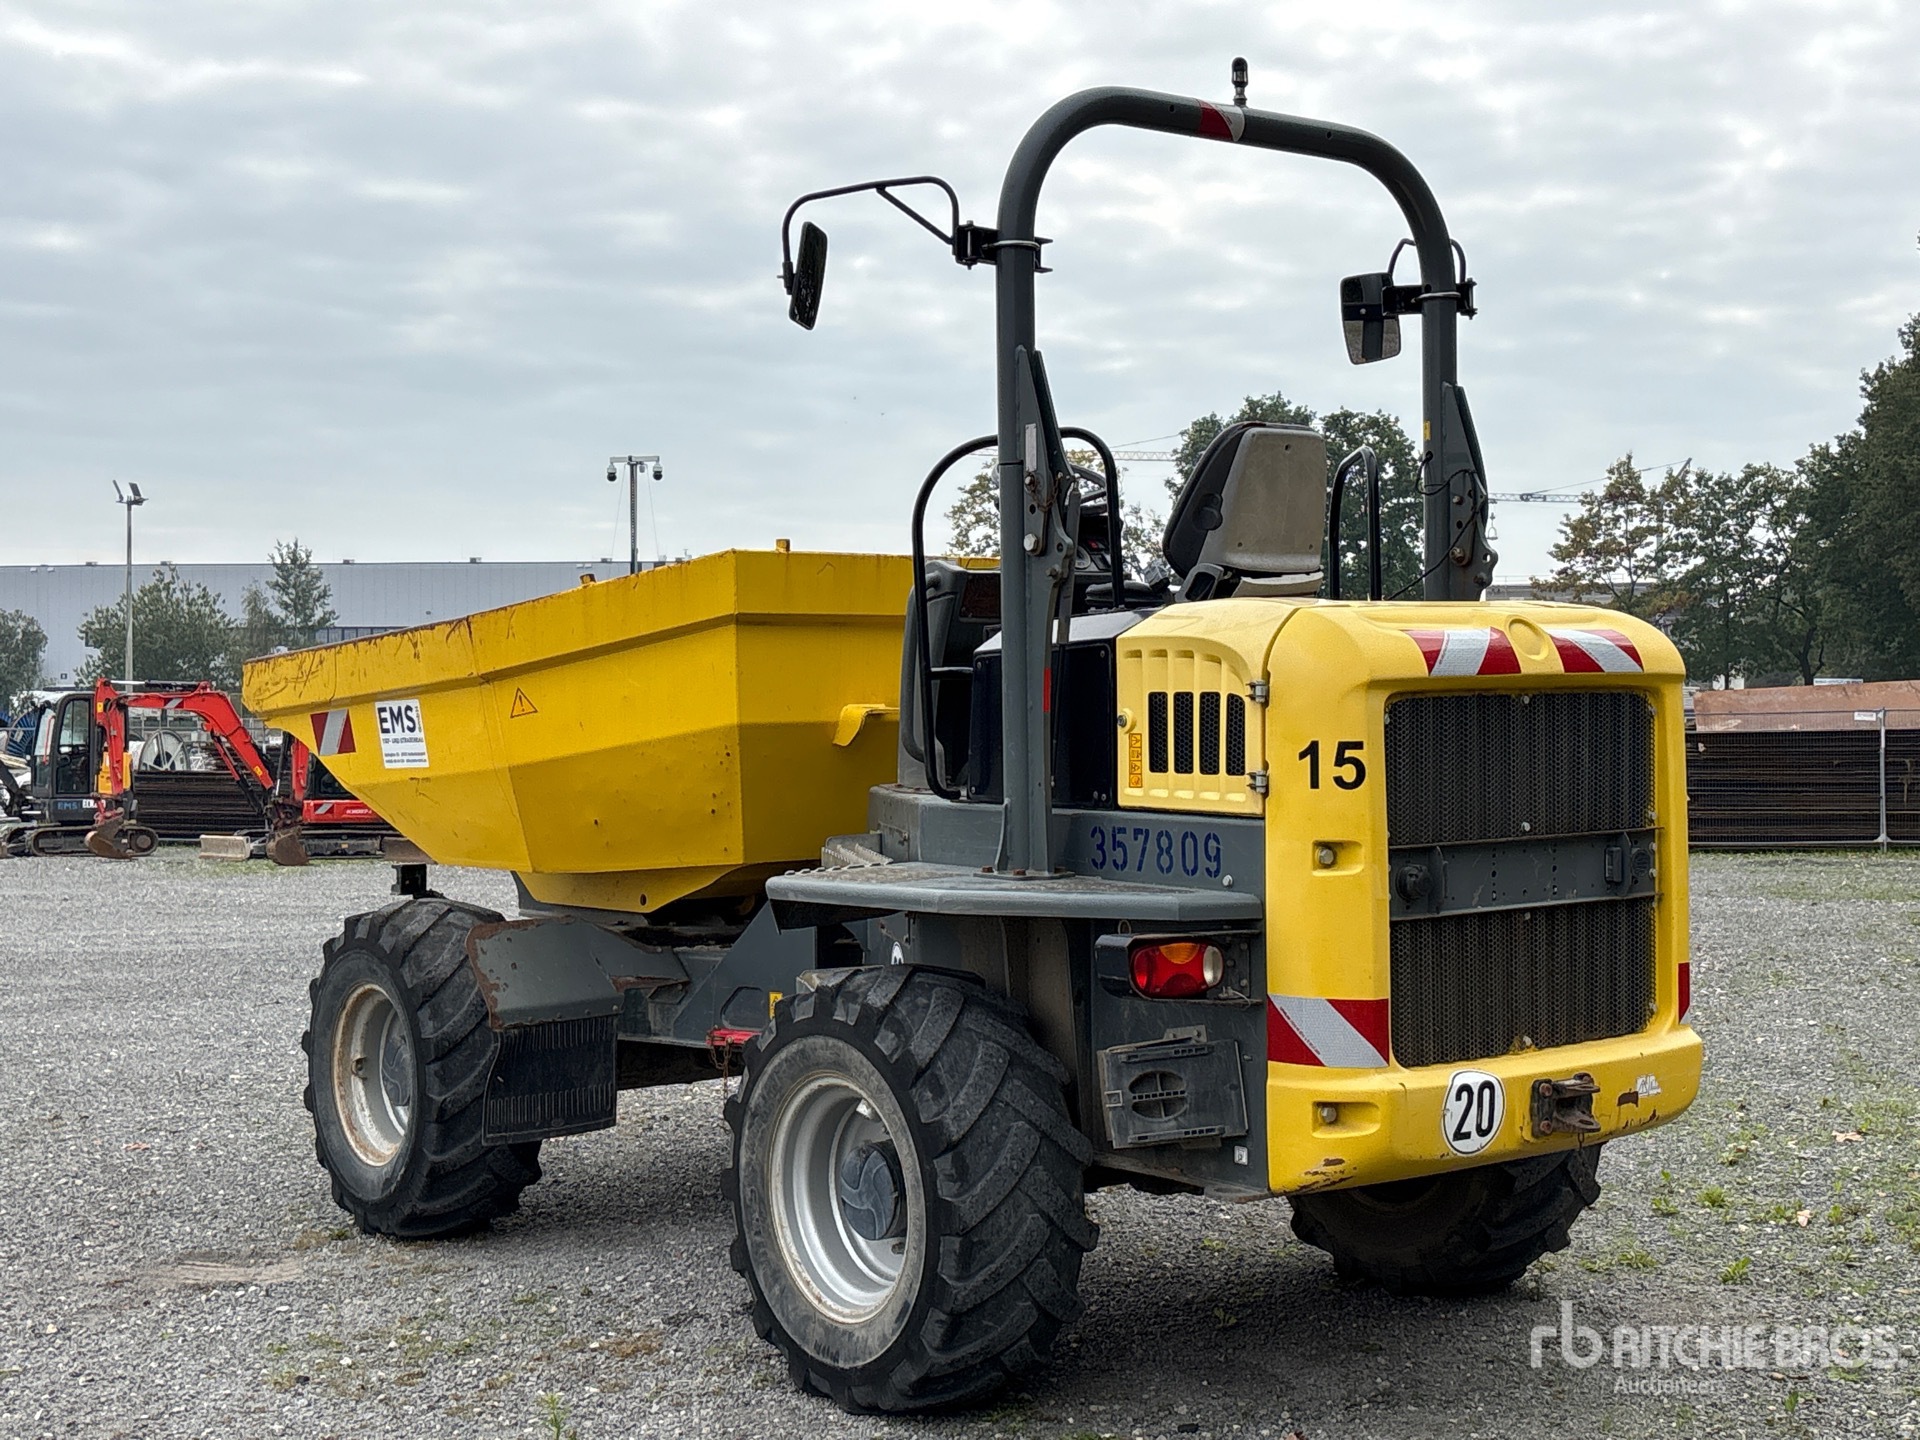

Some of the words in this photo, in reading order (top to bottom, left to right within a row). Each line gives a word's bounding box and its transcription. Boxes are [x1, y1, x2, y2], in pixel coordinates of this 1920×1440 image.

[377, 704, 416, 734] EMS
[1298, 740, 1367, 790] 15
[1090, 826, 1222, 879] 357809
[1453, 1080, 1496, 1142] 20
